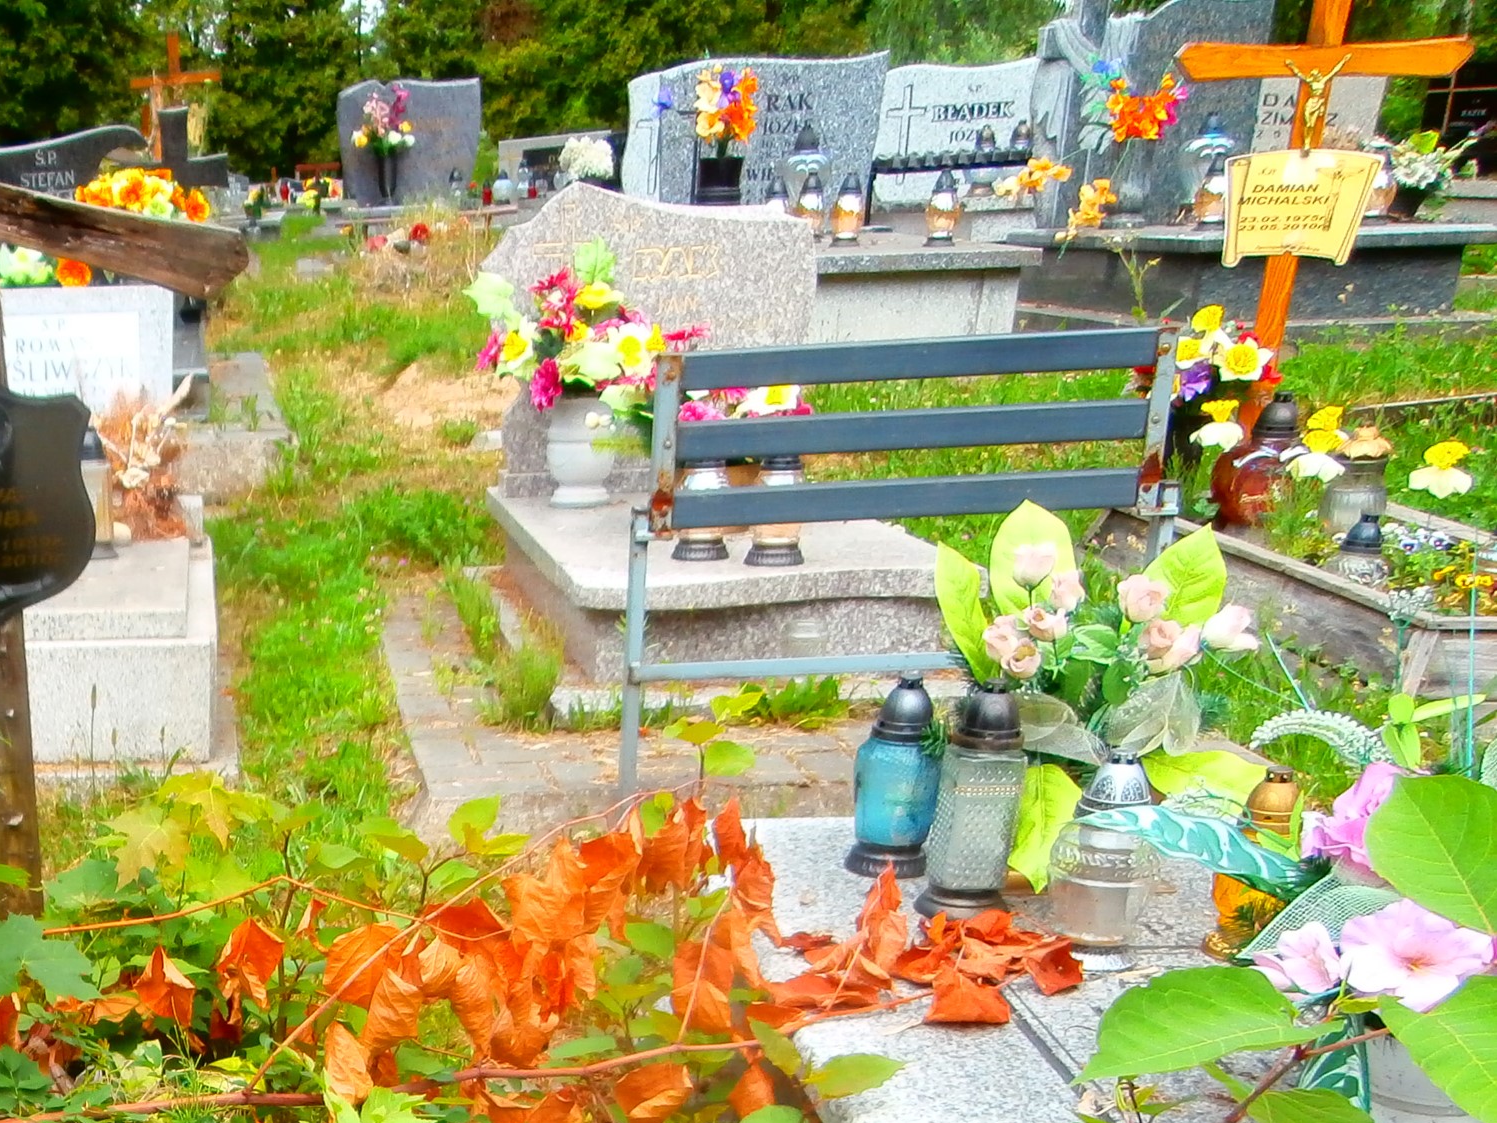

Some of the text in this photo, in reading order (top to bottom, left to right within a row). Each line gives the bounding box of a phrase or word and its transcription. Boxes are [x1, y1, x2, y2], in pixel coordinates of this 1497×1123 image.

[766, 91, 813, 112] RAK
[20, 169, 75, 188] STEFAN
[1252, 184, 1320, 194] DAMIAN
[1237, 195, 1331, 206] MICHALSKI
